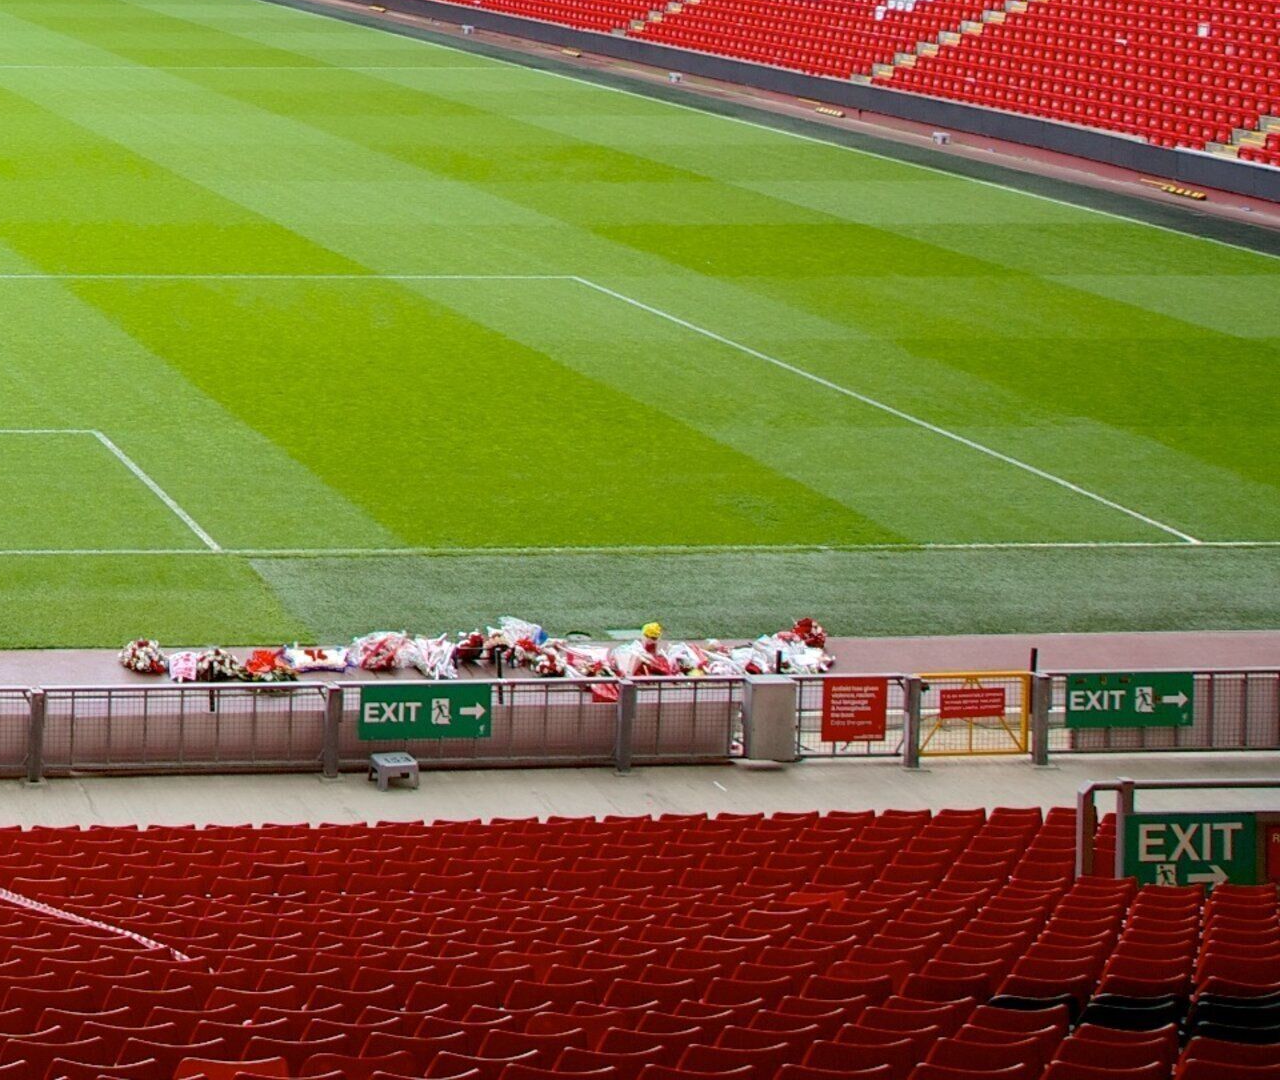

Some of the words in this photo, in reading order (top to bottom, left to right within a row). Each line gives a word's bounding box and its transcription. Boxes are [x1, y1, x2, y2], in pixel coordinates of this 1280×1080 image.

[1070, 690, 1126, 711] EXIT
[364, 702, 422, 723] EXIT
[1138, 822, 1243, 862] EXIT
